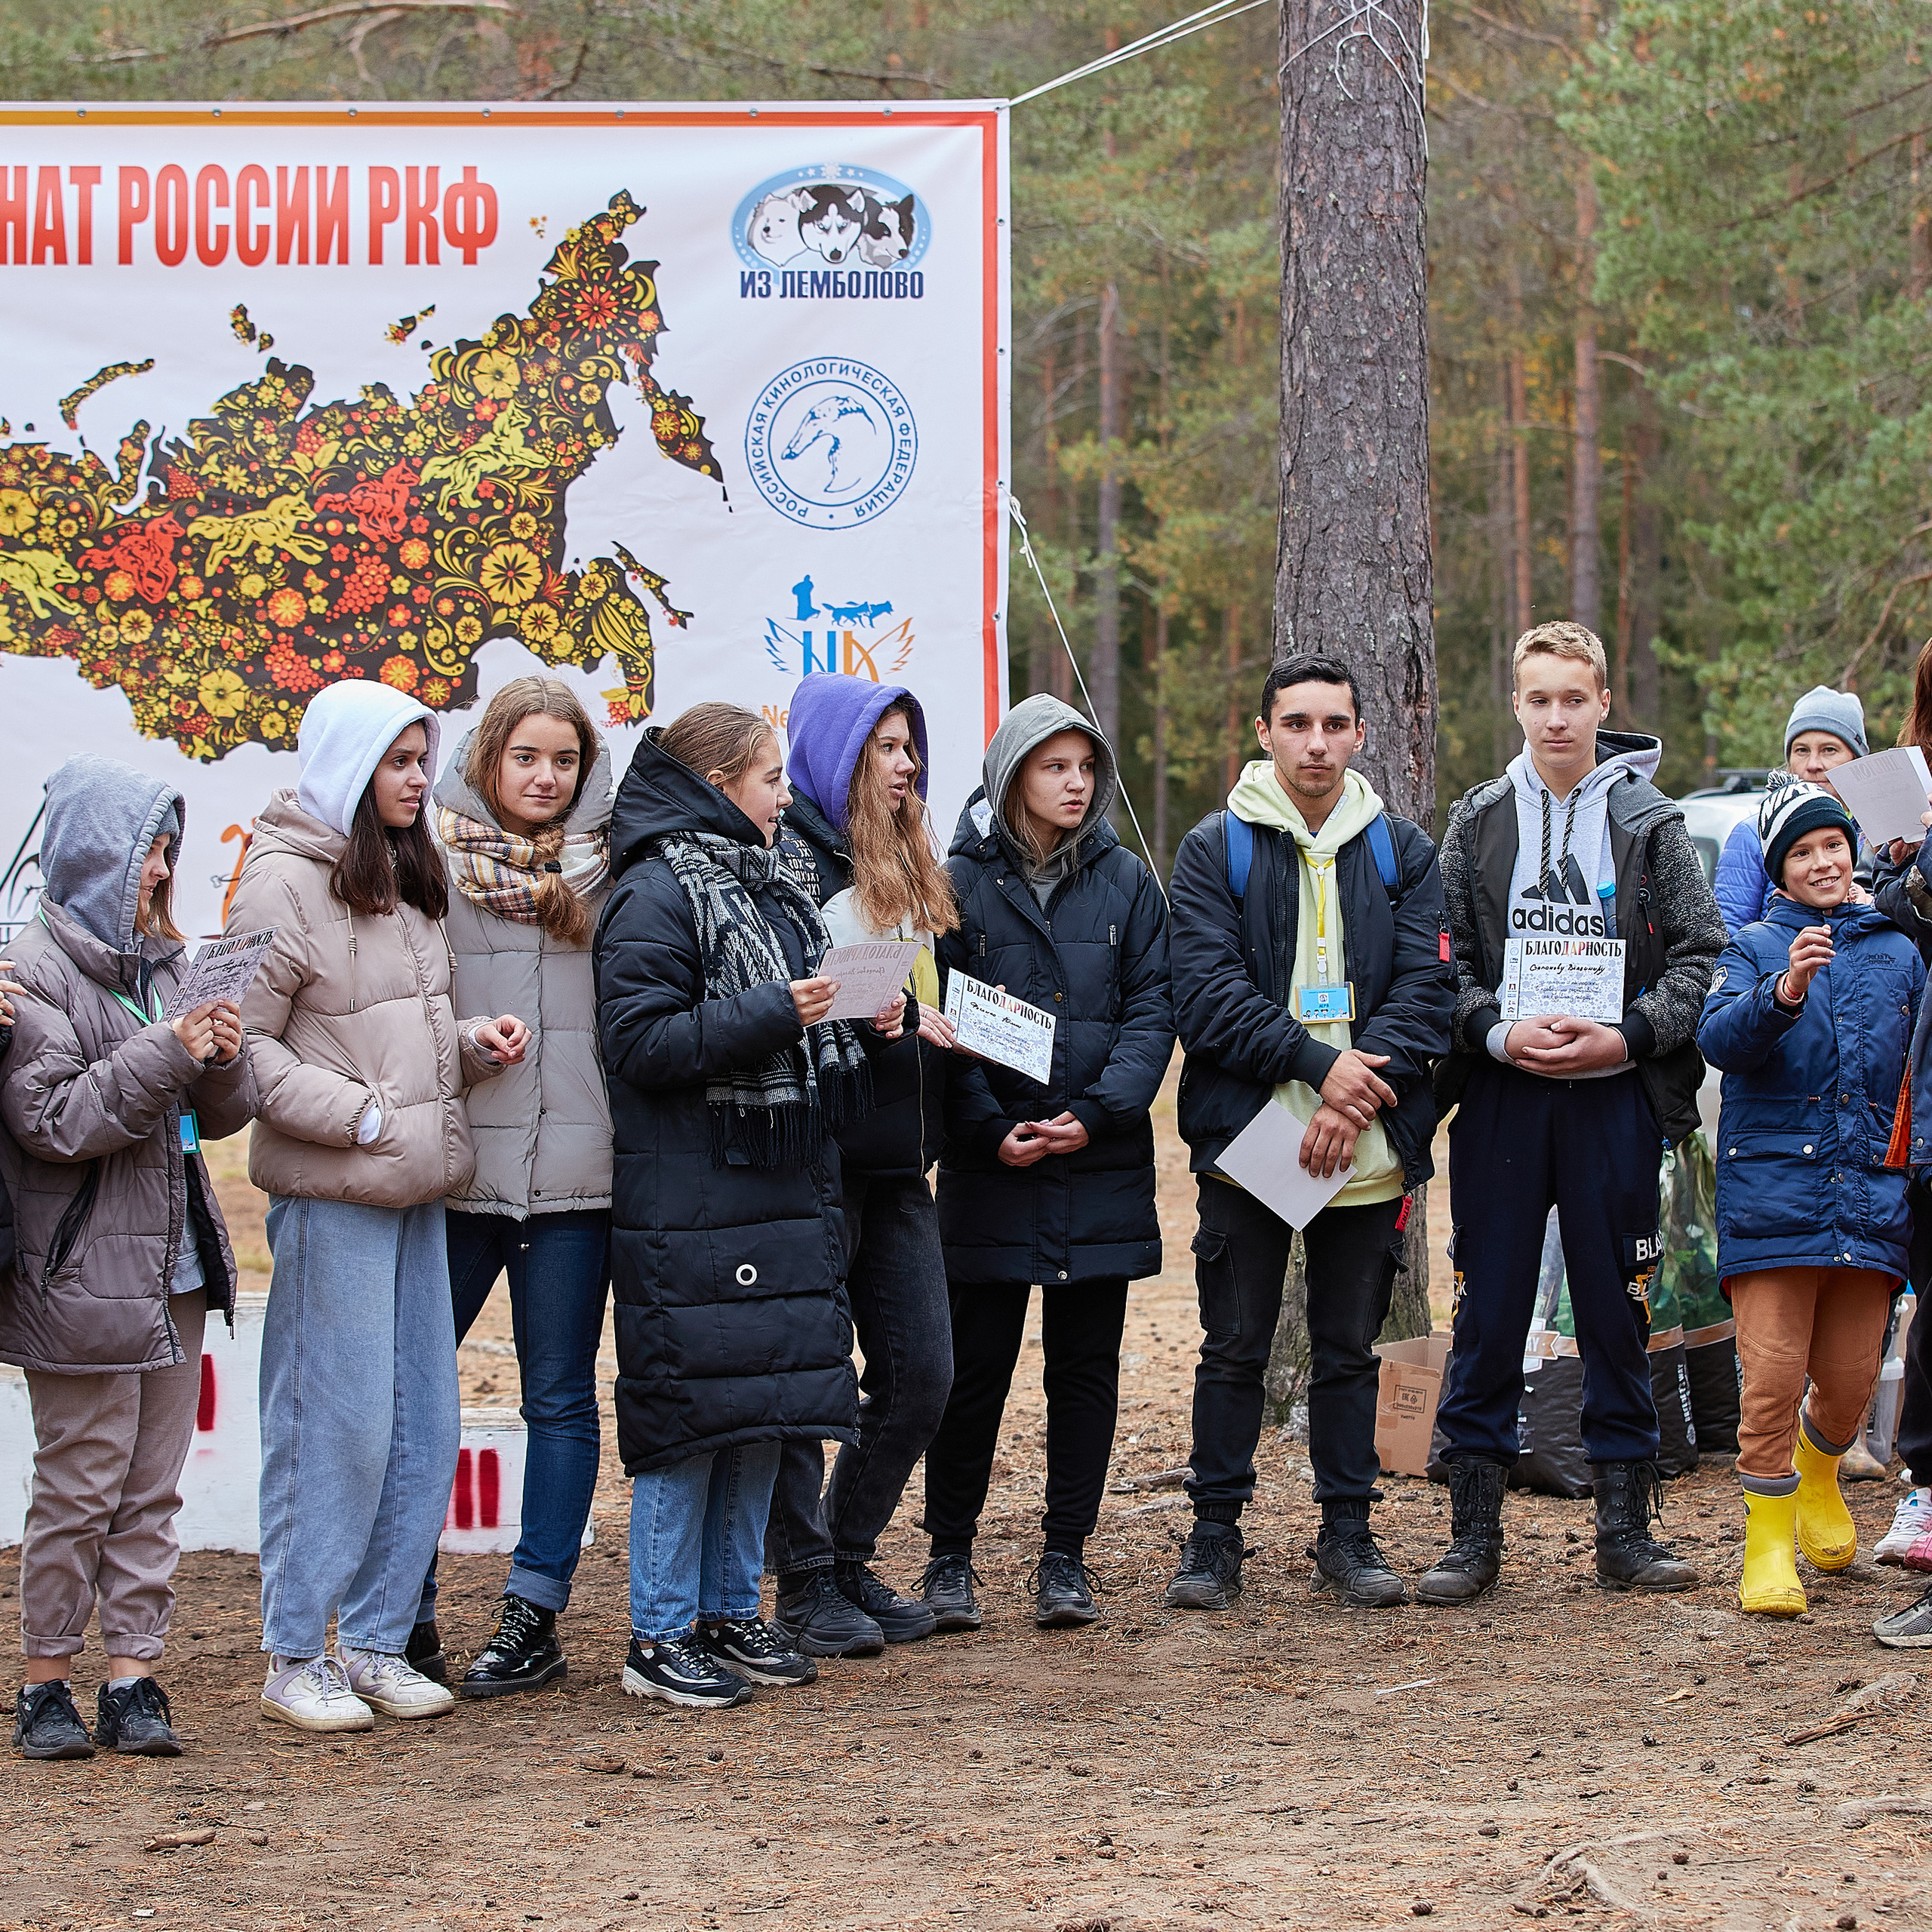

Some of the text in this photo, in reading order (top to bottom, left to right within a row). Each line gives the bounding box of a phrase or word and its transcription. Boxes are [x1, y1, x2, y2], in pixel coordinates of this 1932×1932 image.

[0, 164, 499, 267] НАТ РОССИИ РКФ
[740, 271, 924, 299] ИЗ ЛЕМБОЛОВО
[752, 363, 912, 518] РОССИЙСКАЯ КИНОЛОГИЧЕСКАЯ ФЕДЕРАЦИЯ
[1512, 905, 1604, 937] adidas
[1525, 940, 1622, 957] БЛАГОДАРНОСТЬ
[966, 980, 1052, 1029] БЛАГОДАРНОСТЬ
